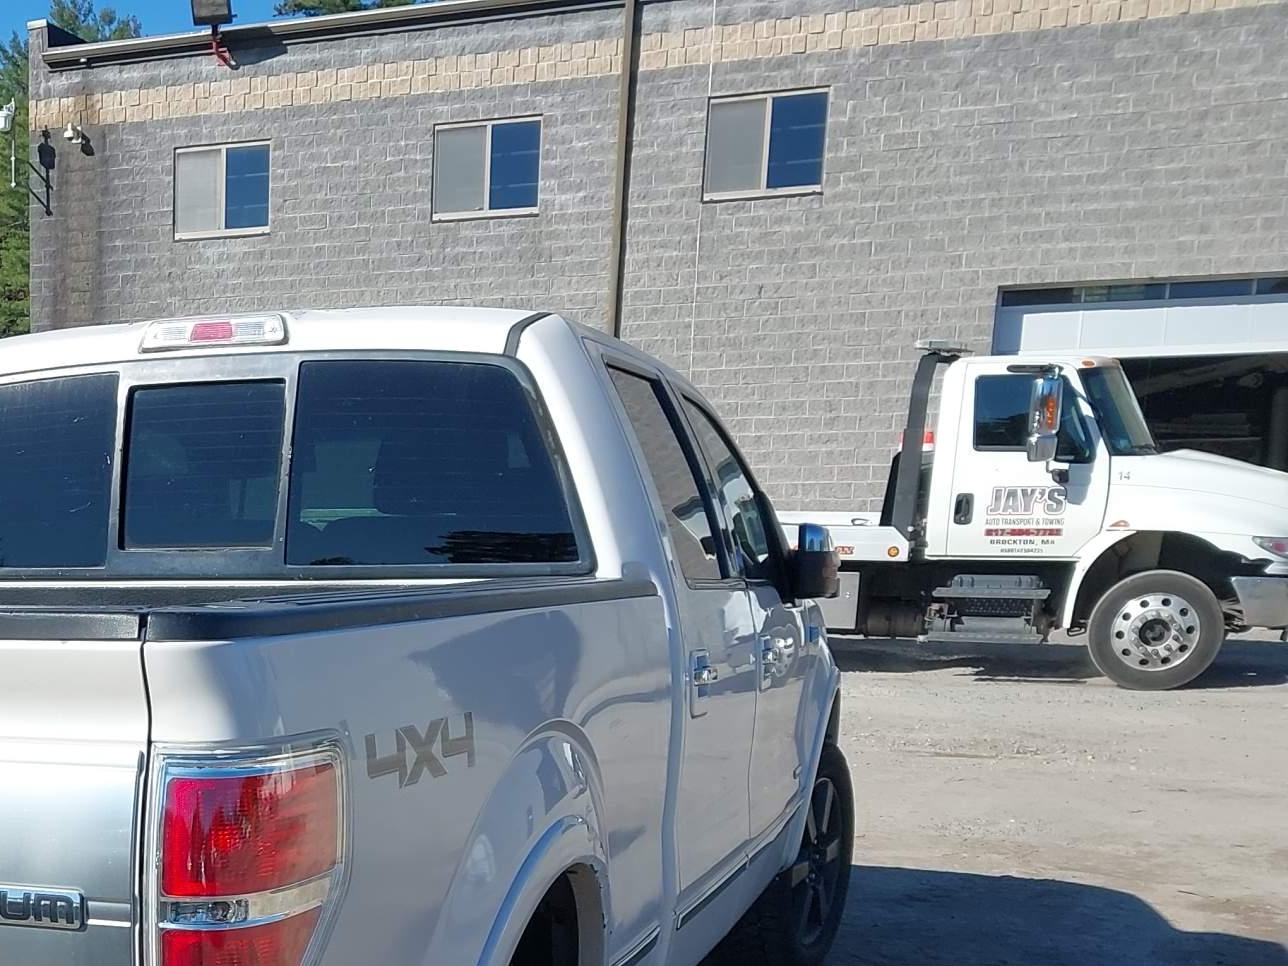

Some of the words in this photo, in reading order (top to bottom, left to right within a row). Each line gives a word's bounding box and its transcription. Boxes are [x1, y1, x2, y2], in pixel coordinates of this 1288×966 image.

[1118, 471, 1132, 481] 14
[987, 486, 1067, 515] JAY'S
[985, 517, 1000, 526] AUTO
[1001, 517, 1034, 526] TRANSPORT
[1042, 517, 1065, 526] TOWING
[364, 711, 476, 788] 4X4
